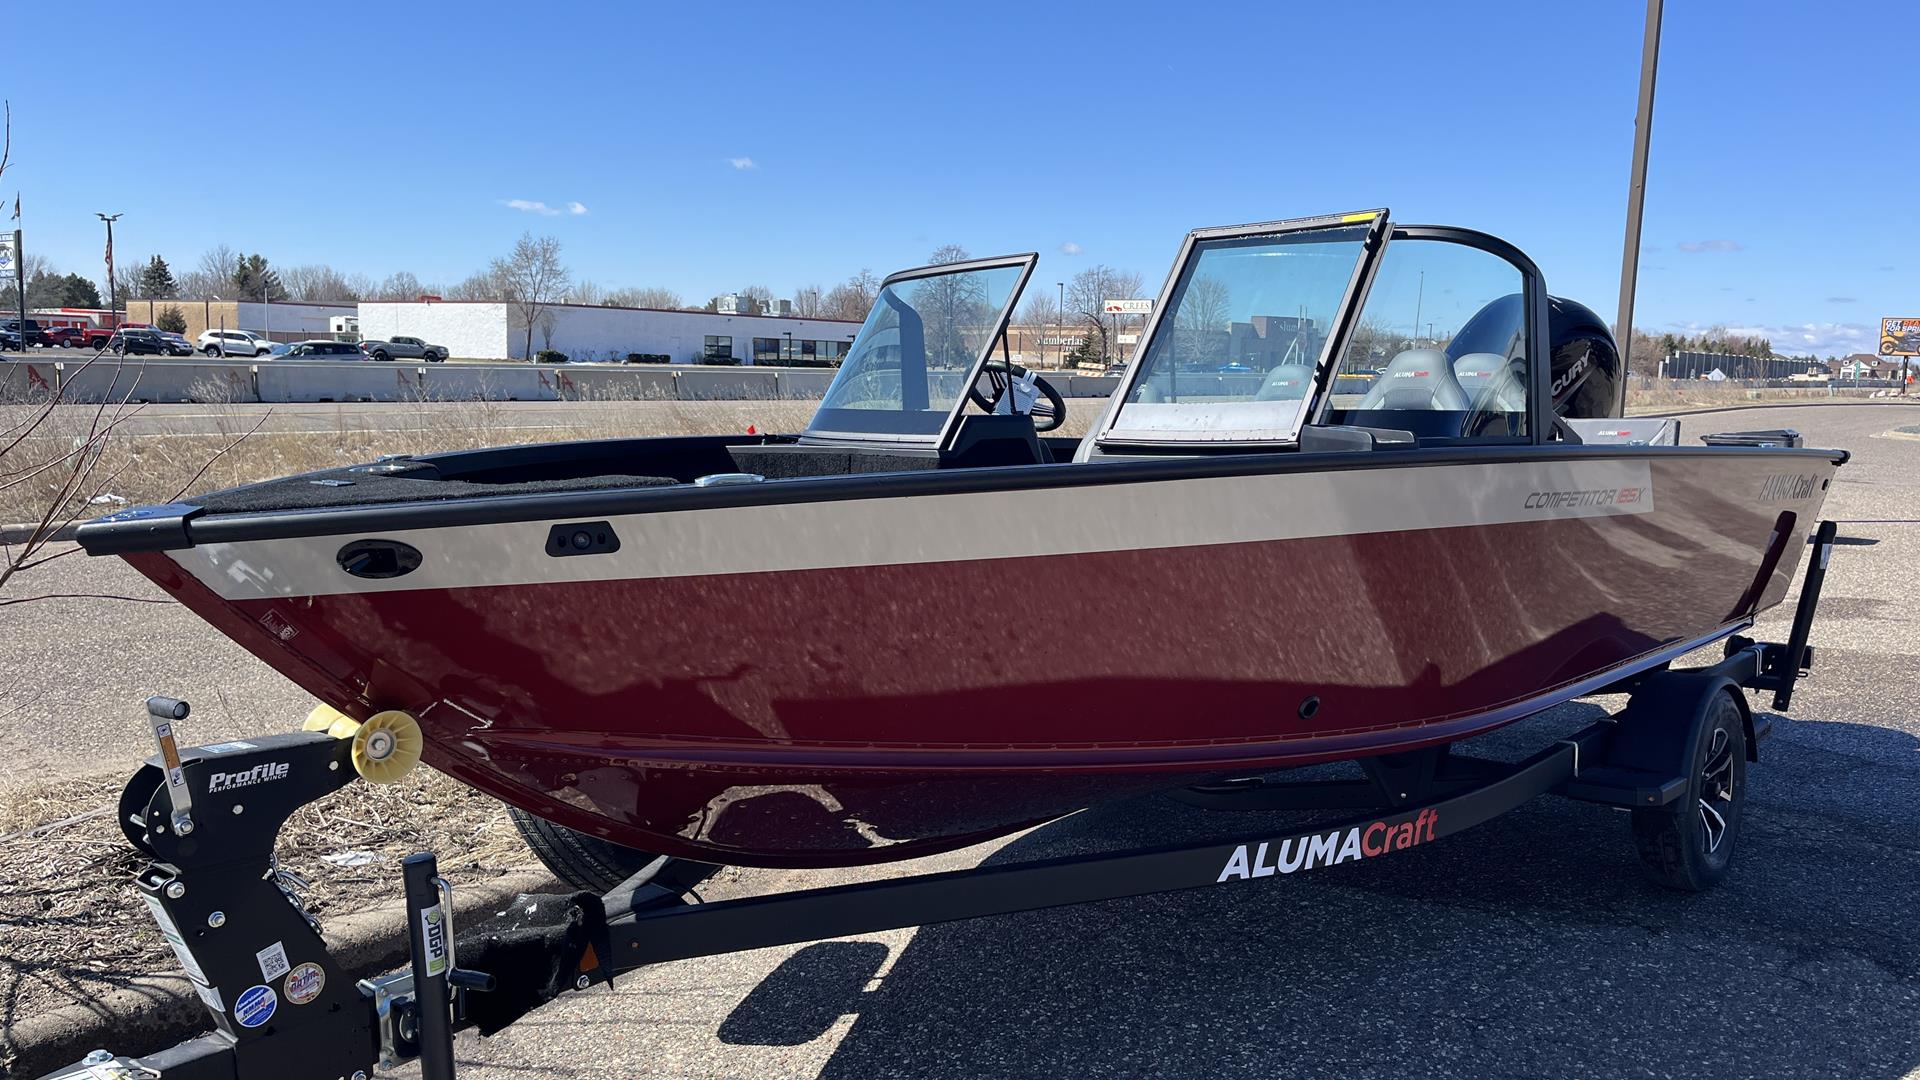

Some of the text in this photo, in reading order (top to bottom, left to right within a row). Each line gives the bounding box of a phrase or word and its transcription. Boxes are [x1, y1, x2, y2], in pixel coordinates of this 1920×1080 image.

[1551, 347, 1592, 397] CURY
[1523, 488, 1617, 509] COMPETITOR
[208, 762, 290, 790] Profile
[208, 773, 288, 794] PERFORMANCE WINCH
[1216, 808, 1438, 883] ALUMACraft
